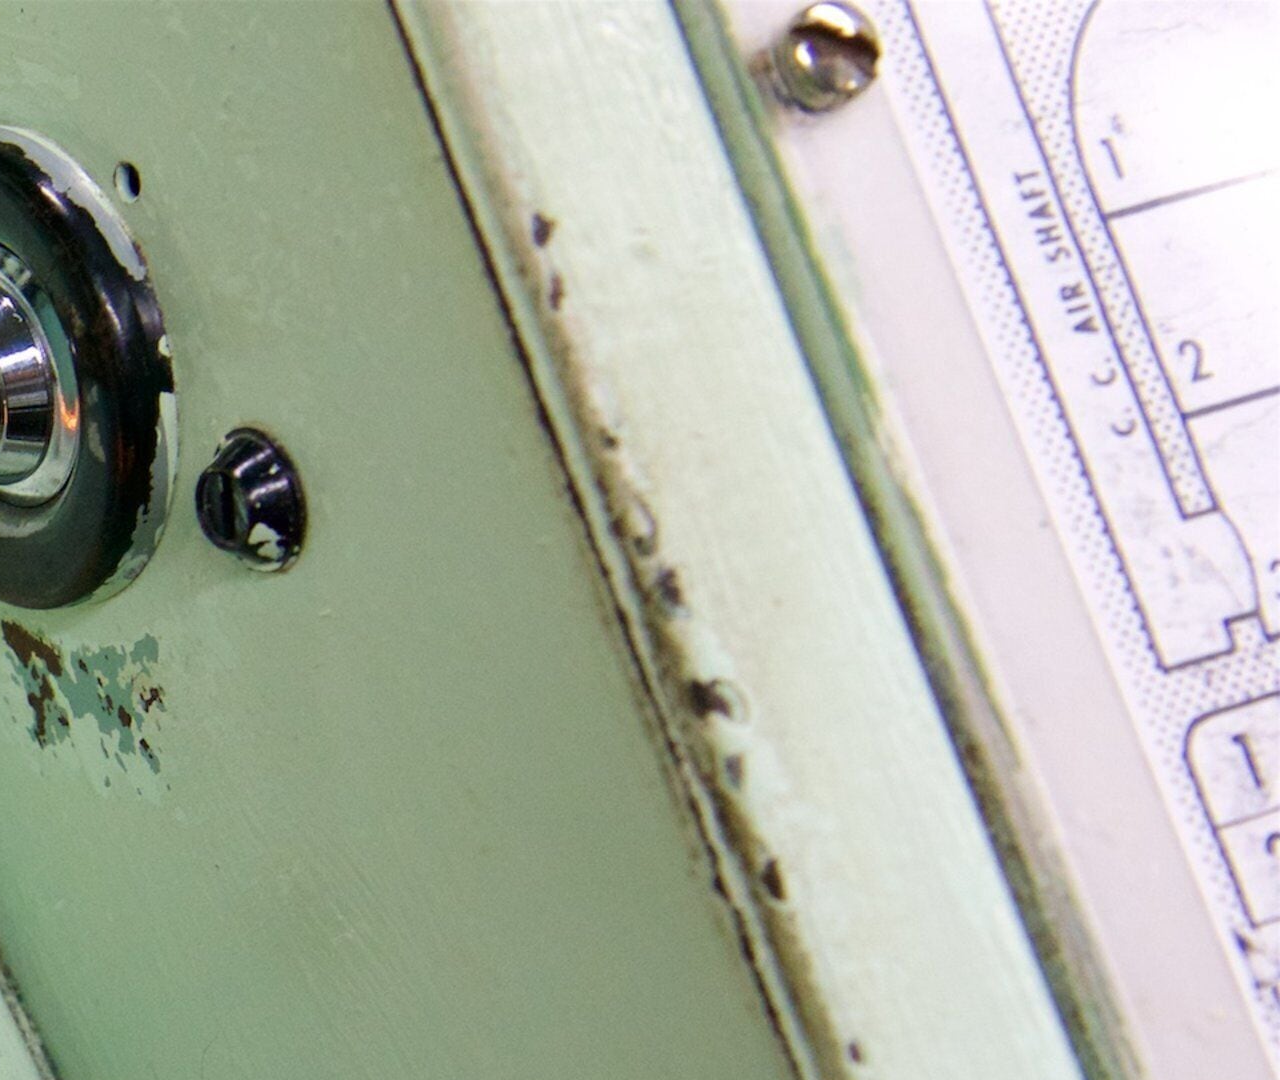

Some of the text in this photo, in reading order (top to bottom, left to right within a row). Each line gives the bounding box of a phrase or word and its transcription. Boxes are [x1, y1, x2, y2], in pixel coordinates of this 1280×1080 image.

[1013, 170, 1072, 263] SHAFT
[1059, 281, 1100, 334] AIR
[1178, 339, 1214, 383] 2
[1231, 733, 1263, 789] 1
